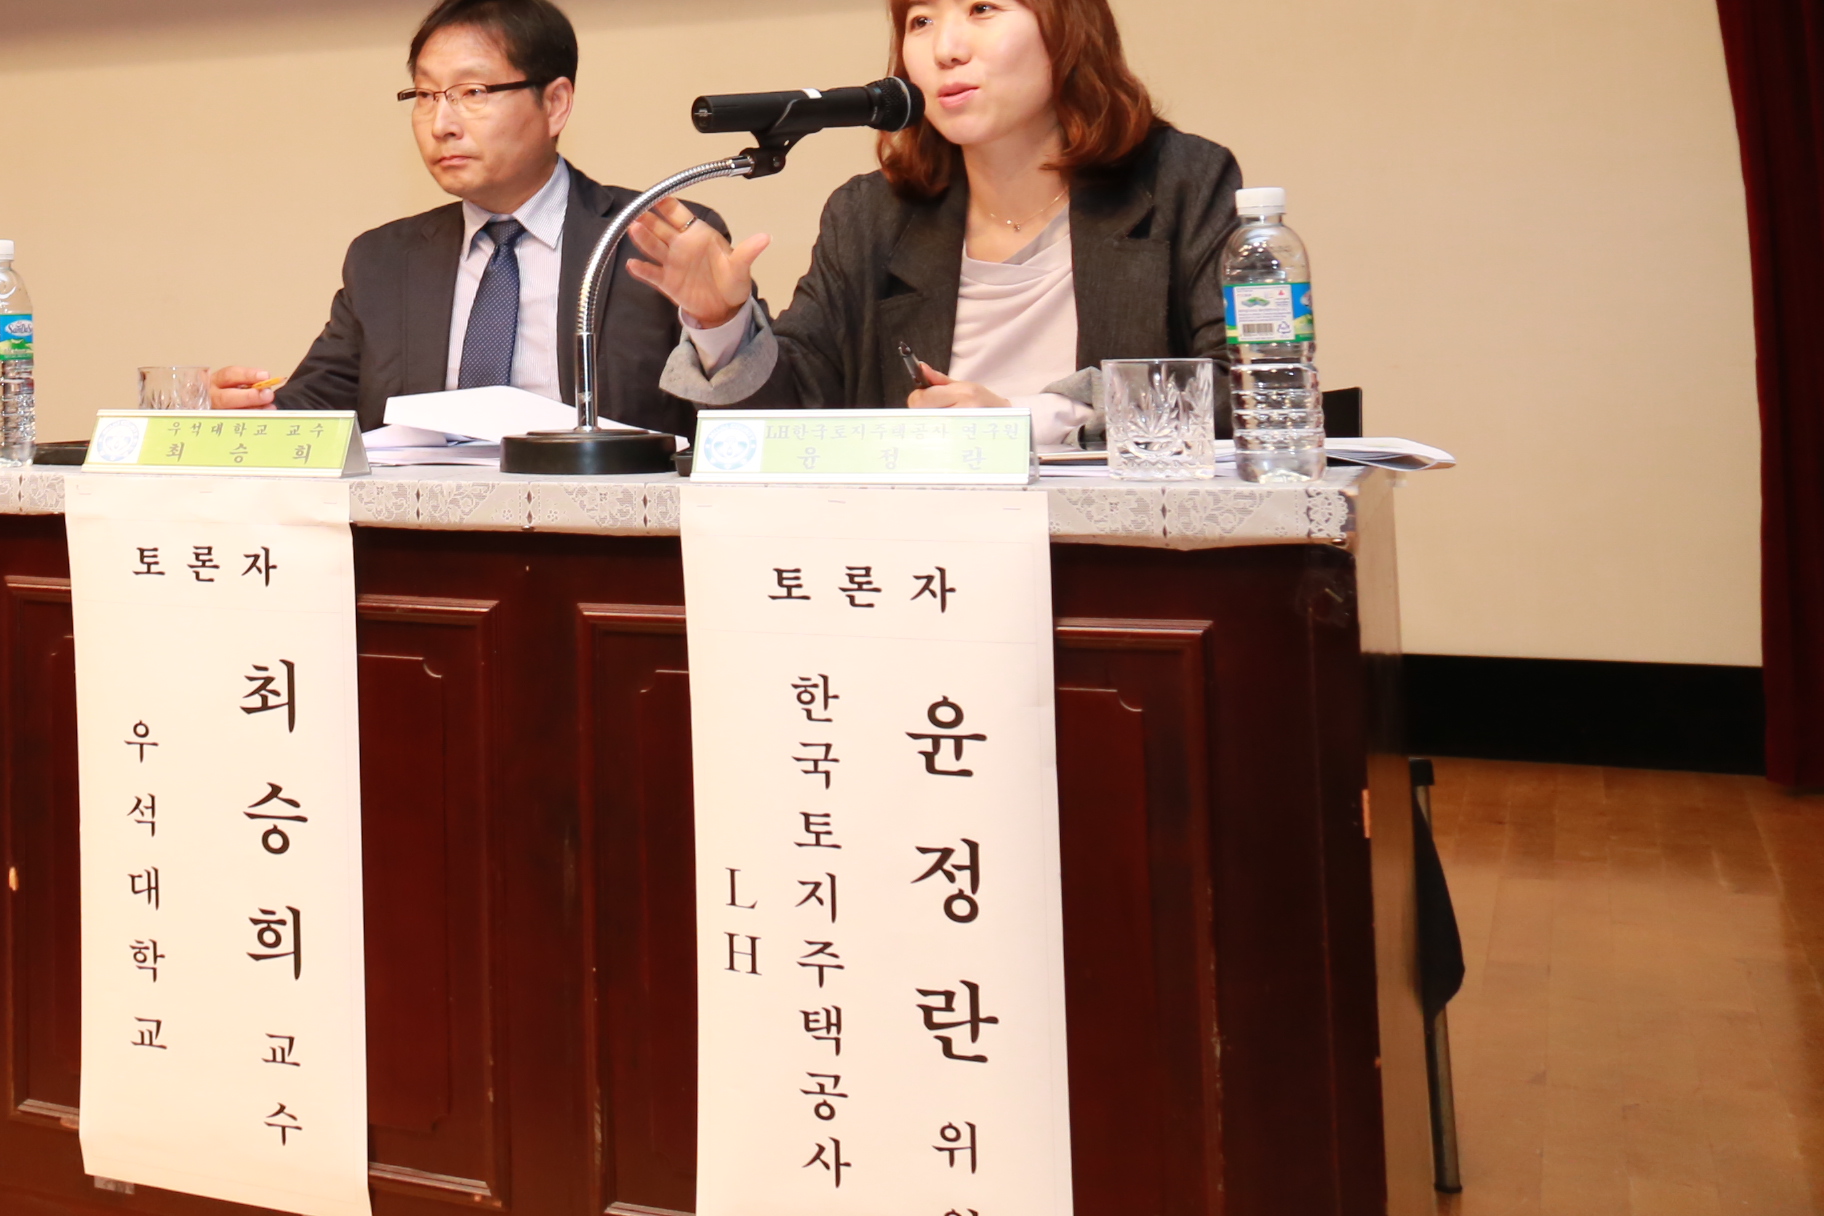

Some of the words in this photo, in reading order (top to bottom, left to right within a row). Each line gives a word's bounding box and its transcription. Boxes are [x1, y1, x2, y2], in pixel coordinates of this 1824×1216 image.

[165, 442, 312, 464] 최승희
[167, 421, 268, 437] 우석대학교
[286, 423, 325, 439] 교수
[961, 423, 1020, 441] 연구원
[797, 446, 987, 471] 윤정란
[133, 546, 277, 587] 토론자
[768, 566, 956, 613] 토론자
[240, 659, 308, 980] 최승희
[125, 720, 167, 1049] 우석대학교
[905, 695, 999, 1063] 윤정란
[724, 868, 761, 975] LH
[791, 674, 851, 1188] 한국토지주택공사
[262, 1034, 302, 1146] 교수
